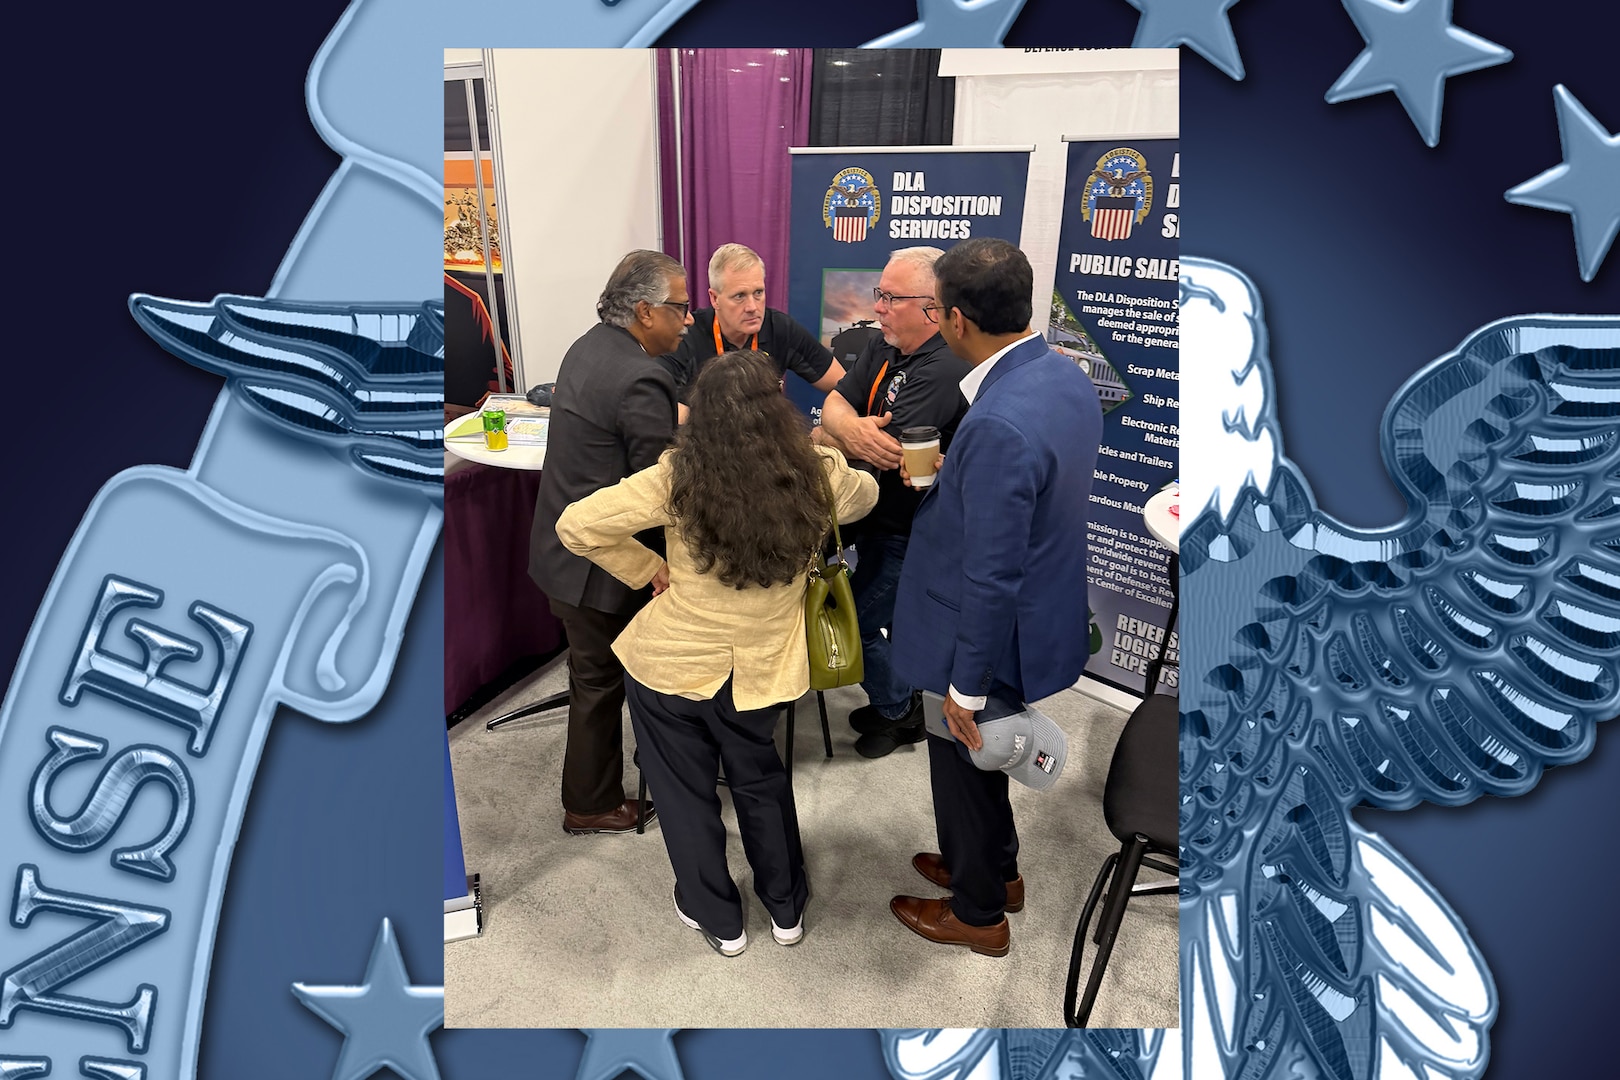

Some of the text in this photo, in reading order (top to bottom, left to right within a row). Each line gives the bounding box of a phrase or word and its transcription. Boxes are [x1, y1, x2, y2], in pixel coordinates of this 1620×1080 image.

[893, 171, 925, 192] DLA
[890, 195, 1002, 216] DISPOSITION
[889, 219, 971, 240] SERVICES
[1069, 253, 1179, 281] PUBLIC SALE
[1077, 290, 1095, 302] The
[1095, 292, 1115, 304] DLA
[1115, 294, 1170, 309] Disposition
[1082, 305, 1124, 319] manages
[1125, 307, 1141, 318] the
[1142, 309, 1163, 321] sale
[1163, 311, 1176, 322] of
[1097, 317, 1179, 337] deemed appropri
[1112, 331, 1179, 350] for the genera
[1127, 363, 1179, 381] Scrap Meta
[1143, 394, 1179, 409] Ship Re
[1121, 416, 1169, 433] Electronic
[1144, 432, 1179, 448] Materia
[1098, 444, 1174, 469] icles and Trailers
[1093, 469, 1150, 492] ble Property
[1088, 494, 1145, 515] zardous Mate
[1119, 529, 1127, 539] is
[1087, 544, 1133, 563] worldwide
[1134, 558, 1168, 572] reverse
[1097, 535, 1114, 546] and
[1115, 541, 1147, 555] protect
[1149, 550, 1165, 561] the
[1092, 555, 1108, 566] Our
[1109, 561, 1129, 572] goal
[1130, 567, 1138, 575] is
[1139, 571, 1149, 579] to
[1095, 578, 1124, 592] Center
[1125, 587, 1135, 596] of
[1136, 591, 1173, 609] Excellen
[1104, 571, 1115, 579] of
[1115, 573, 1157, 593] Defense's
[1159, 587, 1175, 598] Rev
[1111, 649, 1179, 687] EXPETS
[0, 574, 254, 1080] NSE
